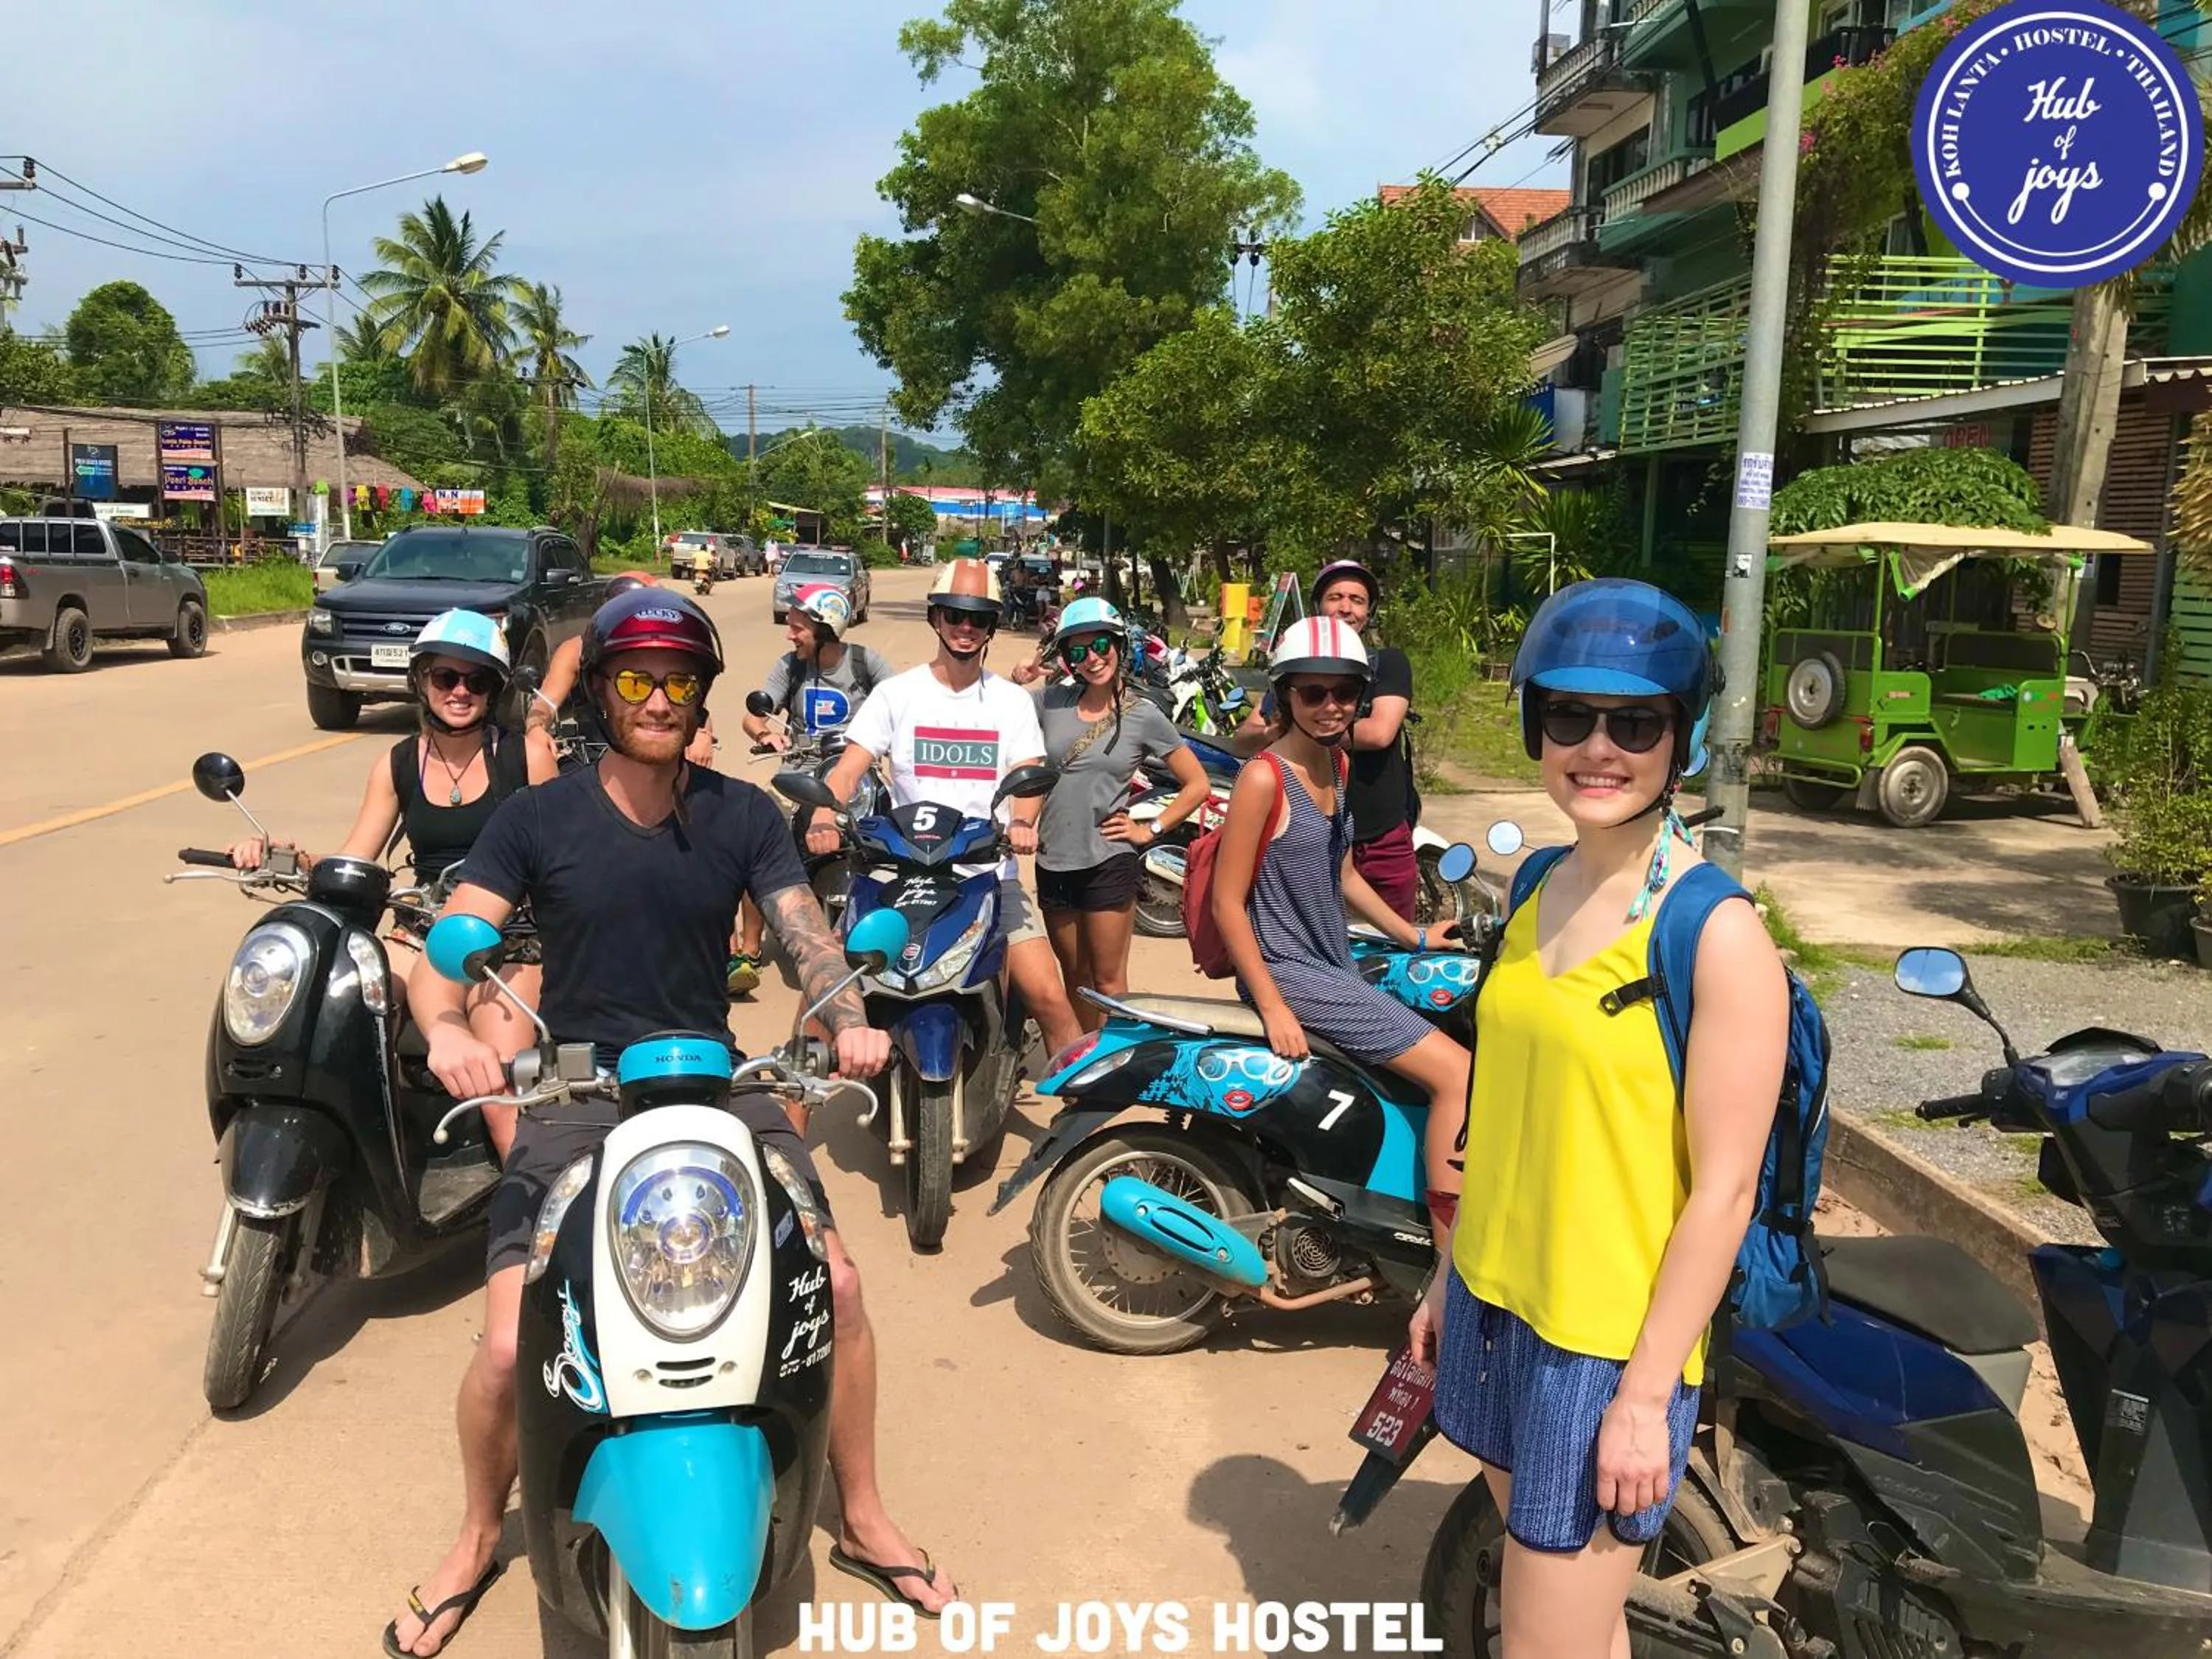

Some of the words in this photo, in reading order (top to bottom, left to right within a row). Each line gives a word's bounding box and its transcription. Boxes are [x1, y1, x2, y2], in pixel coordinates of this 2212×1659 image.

[921, 742, 993, 765] IDOLS
[912, 806, 939, 832] 5
[655, 1054, 703, 1062] HONDA
[1318, 1089, 1354, 1130] 7
[788, 1265, 827, 1303] Hub
[781, 1309, 830, 1360] joys
[1366, 1411, 1405, 1448] 523
